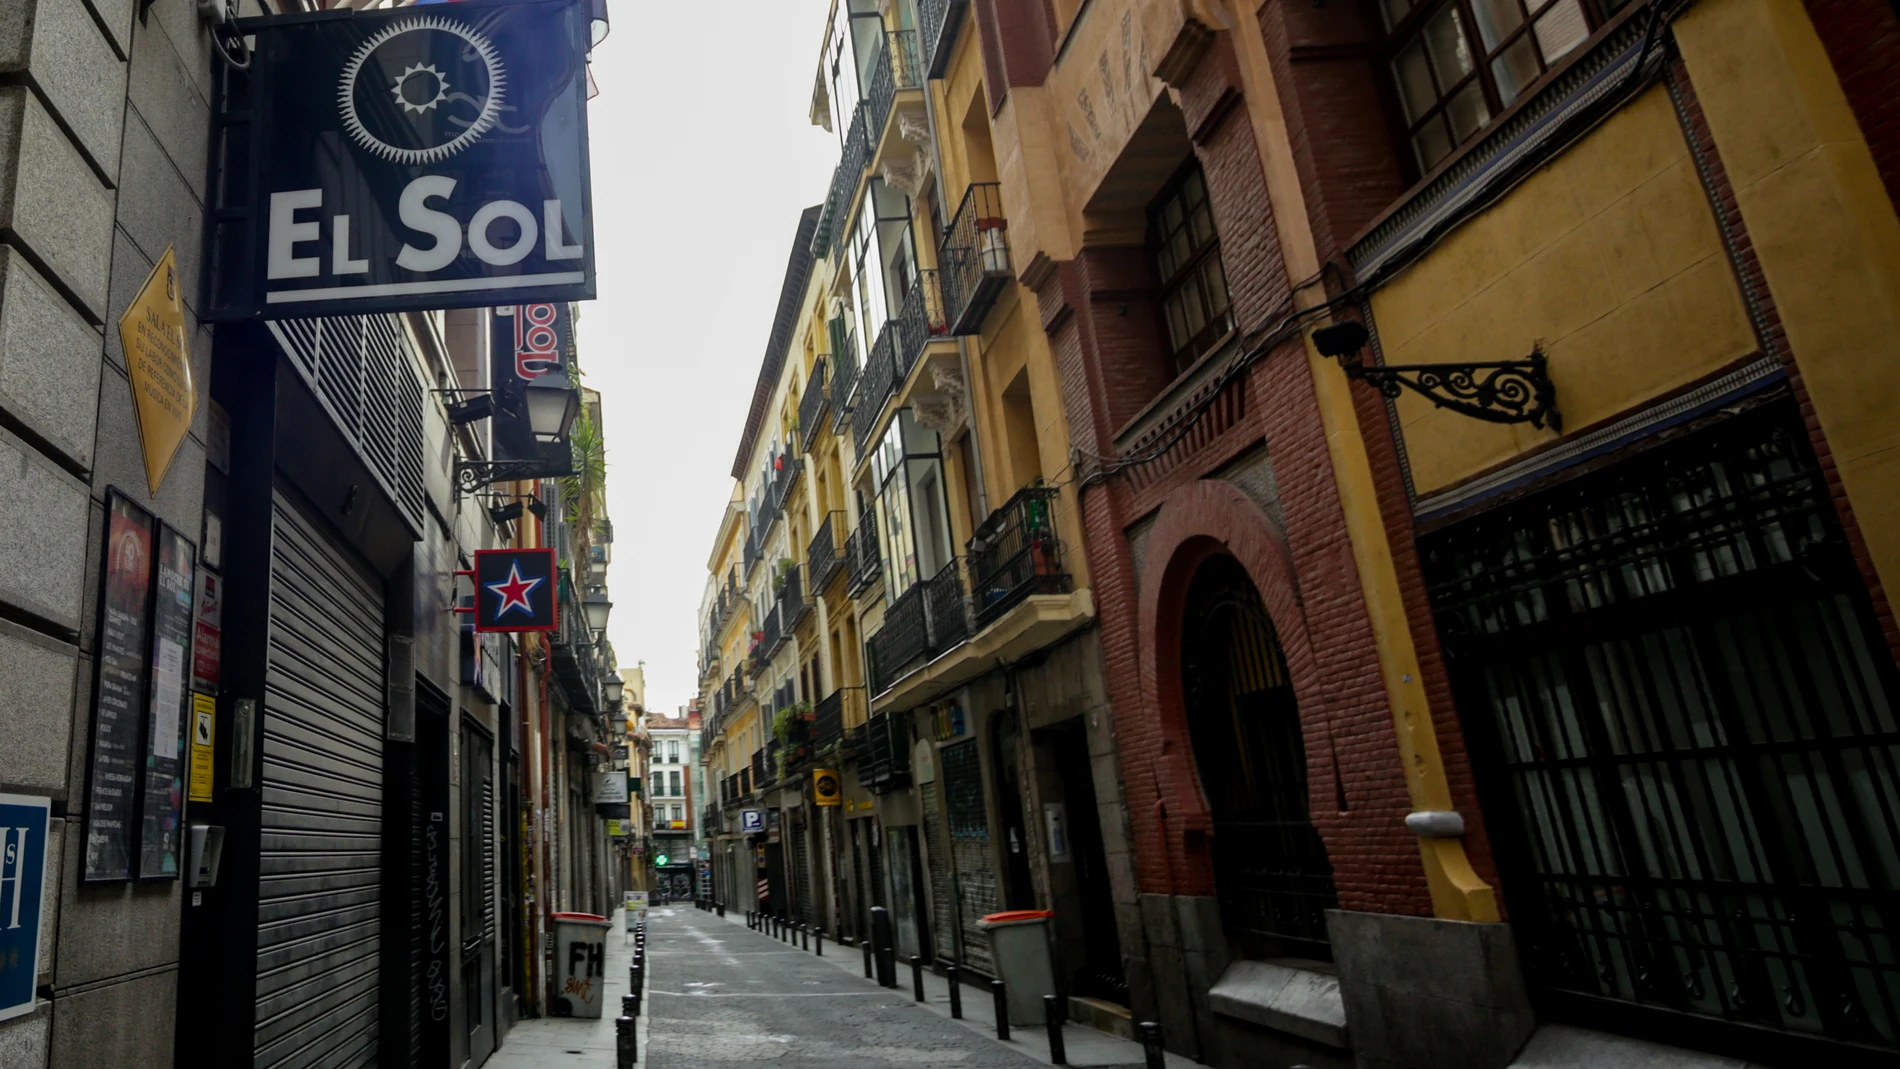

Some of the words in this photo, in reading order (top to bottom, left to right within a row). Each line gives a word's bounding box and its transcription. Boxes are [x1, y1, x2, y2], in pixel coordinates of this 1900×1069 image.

[267, 188, 369, 280] EL
[395, 175, 583, 272] SOL
[138, 321, 147, 339] EN
[146, 306, 166, 336] SALA
[167, 324, 176, 345] EL
[136, 338, 144, 354] SU
[143, 344, 162, 368] LABOR
[138, 358, 146, 374] DE
[146, 364, 176, 398] REFERENCIA
[745, 812, 759, 827] P
